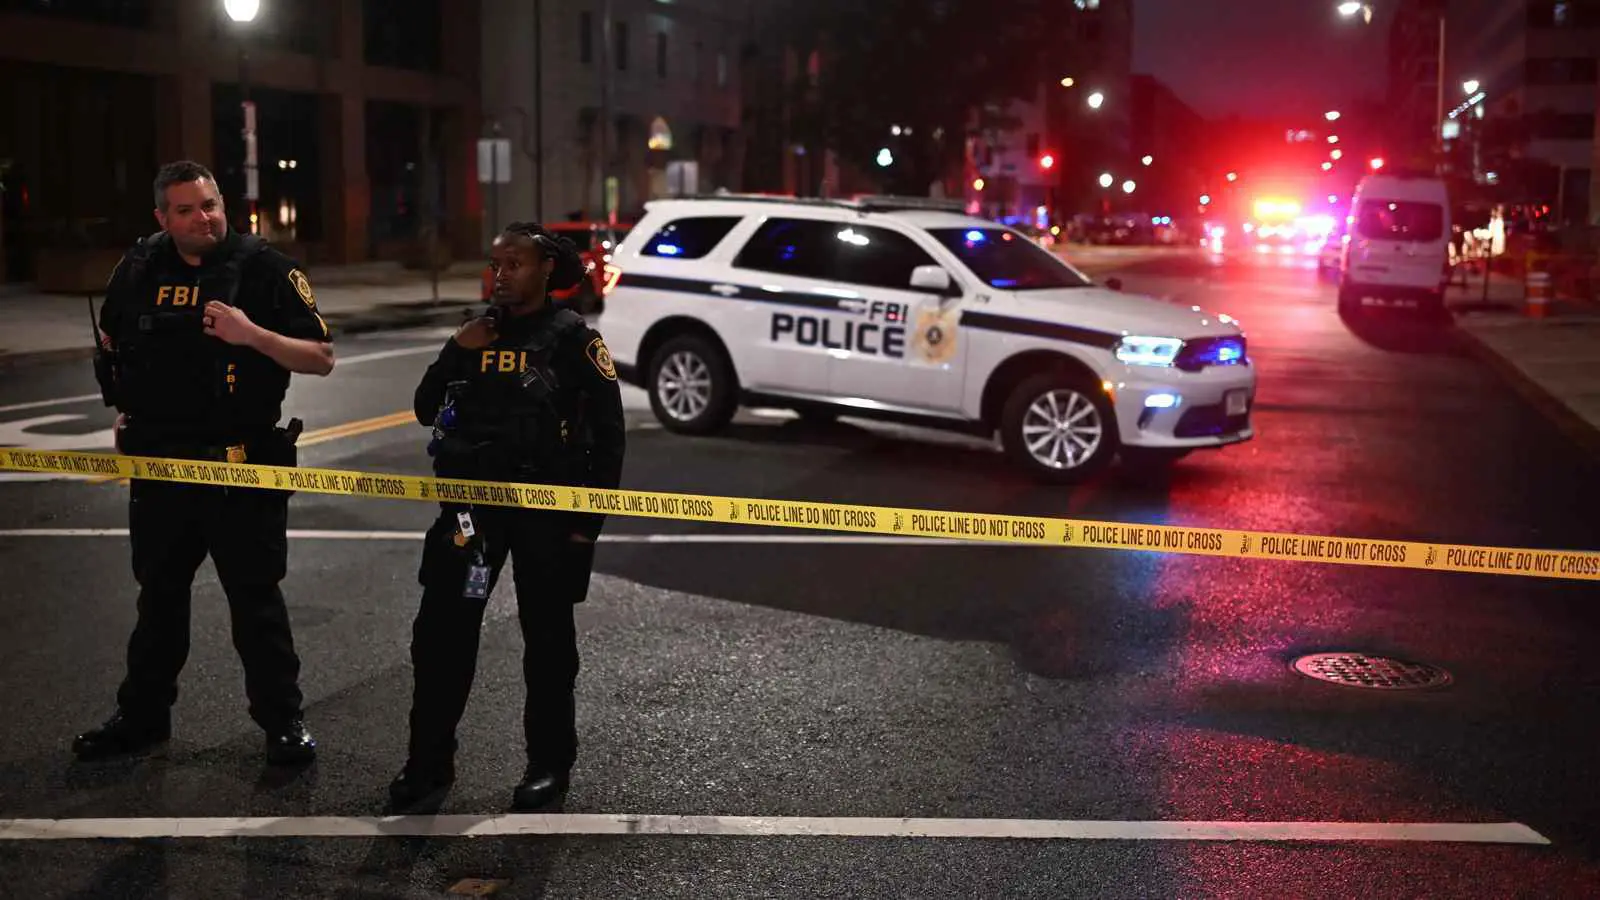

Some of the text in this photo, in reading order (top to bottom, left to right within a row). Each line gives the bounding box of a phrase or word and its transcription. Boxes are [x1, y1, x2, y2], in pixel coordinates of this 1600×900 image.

[157, 286, 199, 305] FBI
[869, 301, 909, 324] FBI
[770, 312, 905, 358] POLICE
[481, 351, 527, 373] FBI
[226, 364, 236, 393] FBI
[9, 452, 39, 468] POLICE
[40, 455, 59, 469] LINE
[59, 456, 73, 471] DO
[73, 457, 90, 472] NOT
[91, 459, 119, 474] CROSS
[146, 462, 176, 478] POLICE
[177, 464, 197, 480] LINE
[198, 465, 211, 481] DO
[212, 466, 229, 482] NOT
[230, 468, 260, 484] CROSS
[288, 472, 320, 489] POLICE
[321, 474, 341, 490] LINE
[341, 476, 354, 492] DO
[355, 477, 374, 494] NOT
[375, 479, 406, 496] CROSS
[436, 482, 469, 499] POLICE
[469, 485, 489, 501] LINE
[490, 486, 503, 502] DO
[504, 487, 523, 505] NOT
[525, 489, 556, 506] CROSS
[588, 493, 621, 510] POLICE
[622, 495, 644, 512] LINE
[645, 497, 659, 513] DO
[661, 498, 680, 515] NOT
[681, 499, 713, 517] CROSS
[747, 504, 780, 521] POLICE
[783, 505, 804, 523] LINE
[806, 507, 820, 524] DO
[822, 508, 842, 526] NOT
[844, 510, 876, 528] CROSS
[912, 514, 946, 532] POLICE
[948, 516, 970, 534] LINE
[973, 518, 987, 535] DO
[989, 519, 1009, 537] NOT
[1011, 521, 1045, 539] CROSS
[1083, 525, 1118, 544] POLICE
[1121, 528, 1144, 546] LINE
[1146, 529, 1161, 547] DO
[1163, 530, 1185, 548] NOT
[1187, 532, 1222, 550] CROSS
[1261, 537, 1298, 556] POLICE
[1301, 539, 1325, 557] LINE
[1327, 540, 1343, 559] DO
[1345, 542, 1368, 560] NOT
[1369, 543, 1407, 562] CROSS
[1446, 549, 1486, 568] POLICE
[1488, 551, 1514, 569] LINE
[1516, 552, 1532, 571] DO
[1534, 553, 1559, 572] NOT
[1560, 555, 1600, 575] CROSS
